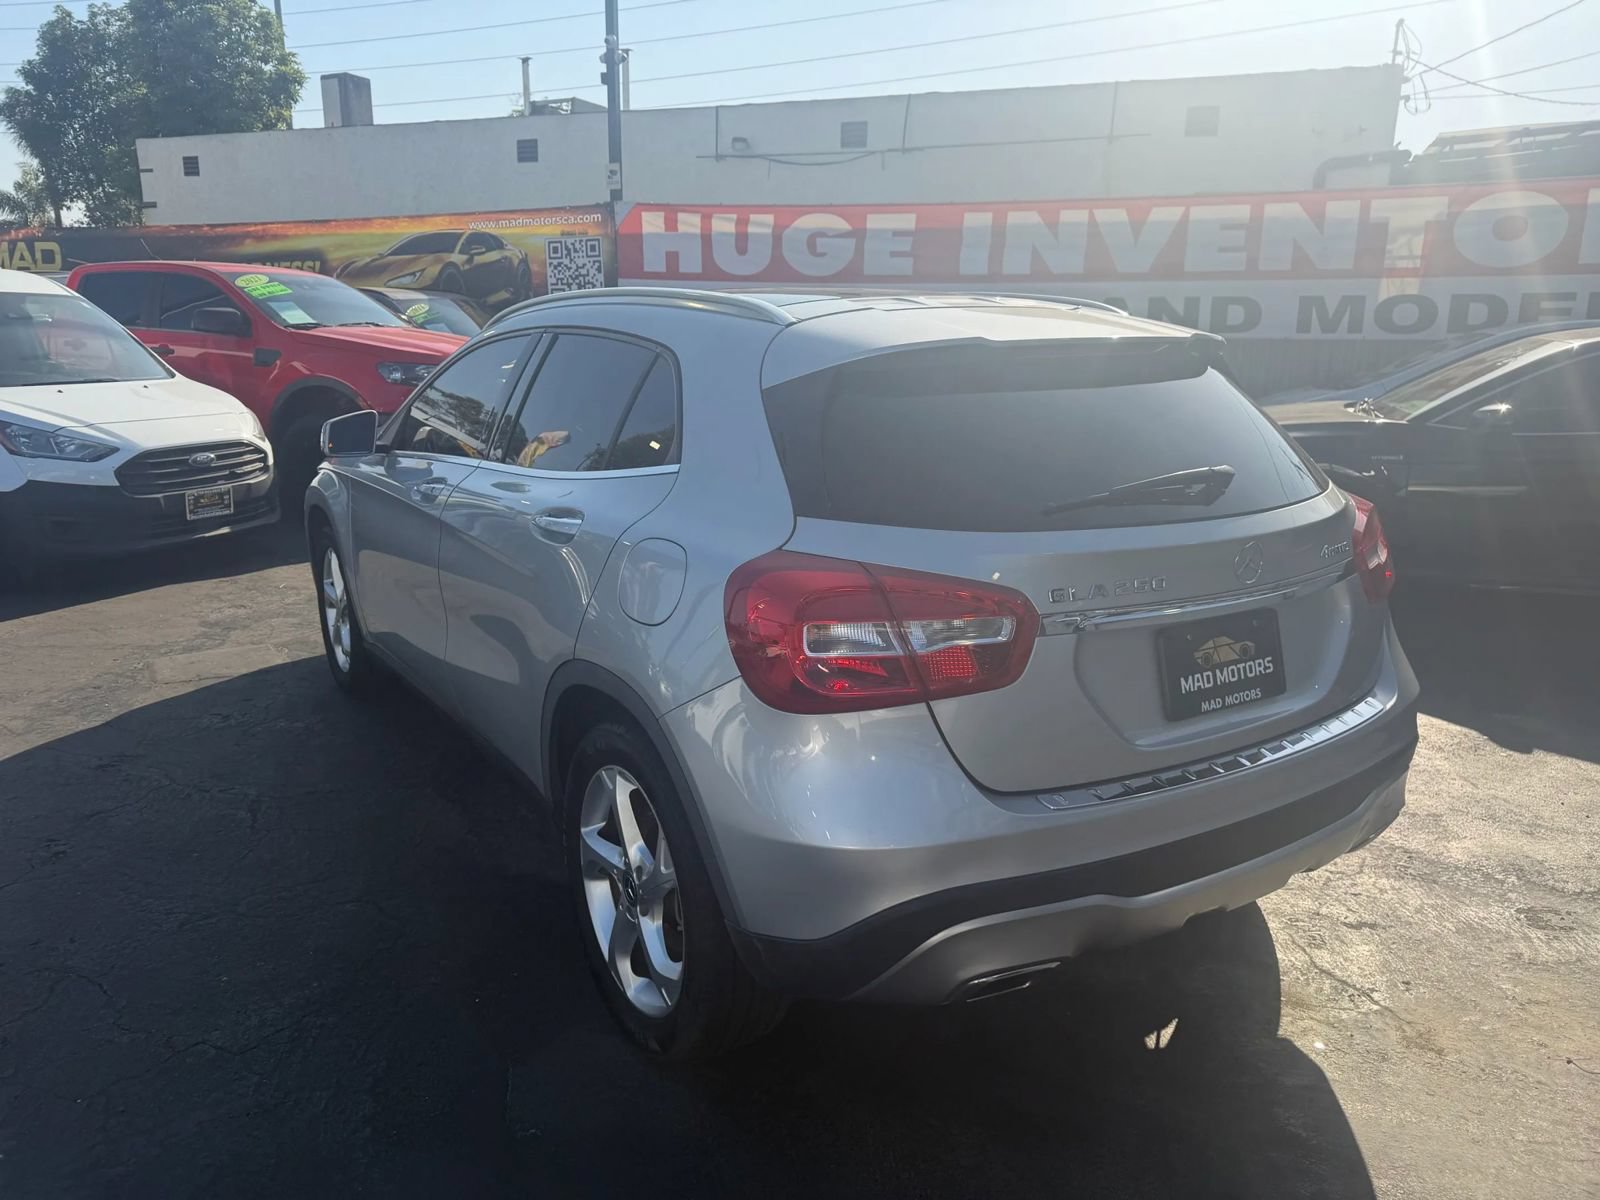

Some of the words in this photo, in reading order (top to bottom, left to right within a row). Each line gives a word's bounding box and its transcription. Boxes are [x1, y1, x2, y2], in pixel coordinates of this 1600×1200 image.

[469, 213, 602, 230] www.madmotorsca.com
[641, 211, 917, 277] HUGE
[1180, 671, 1214, 694] MAD
[1215, 656, 1274, 685] MOTORS
[1201, 698, 1223, 713] MAD
[1225, 688, 1262, 706] MOTORS
